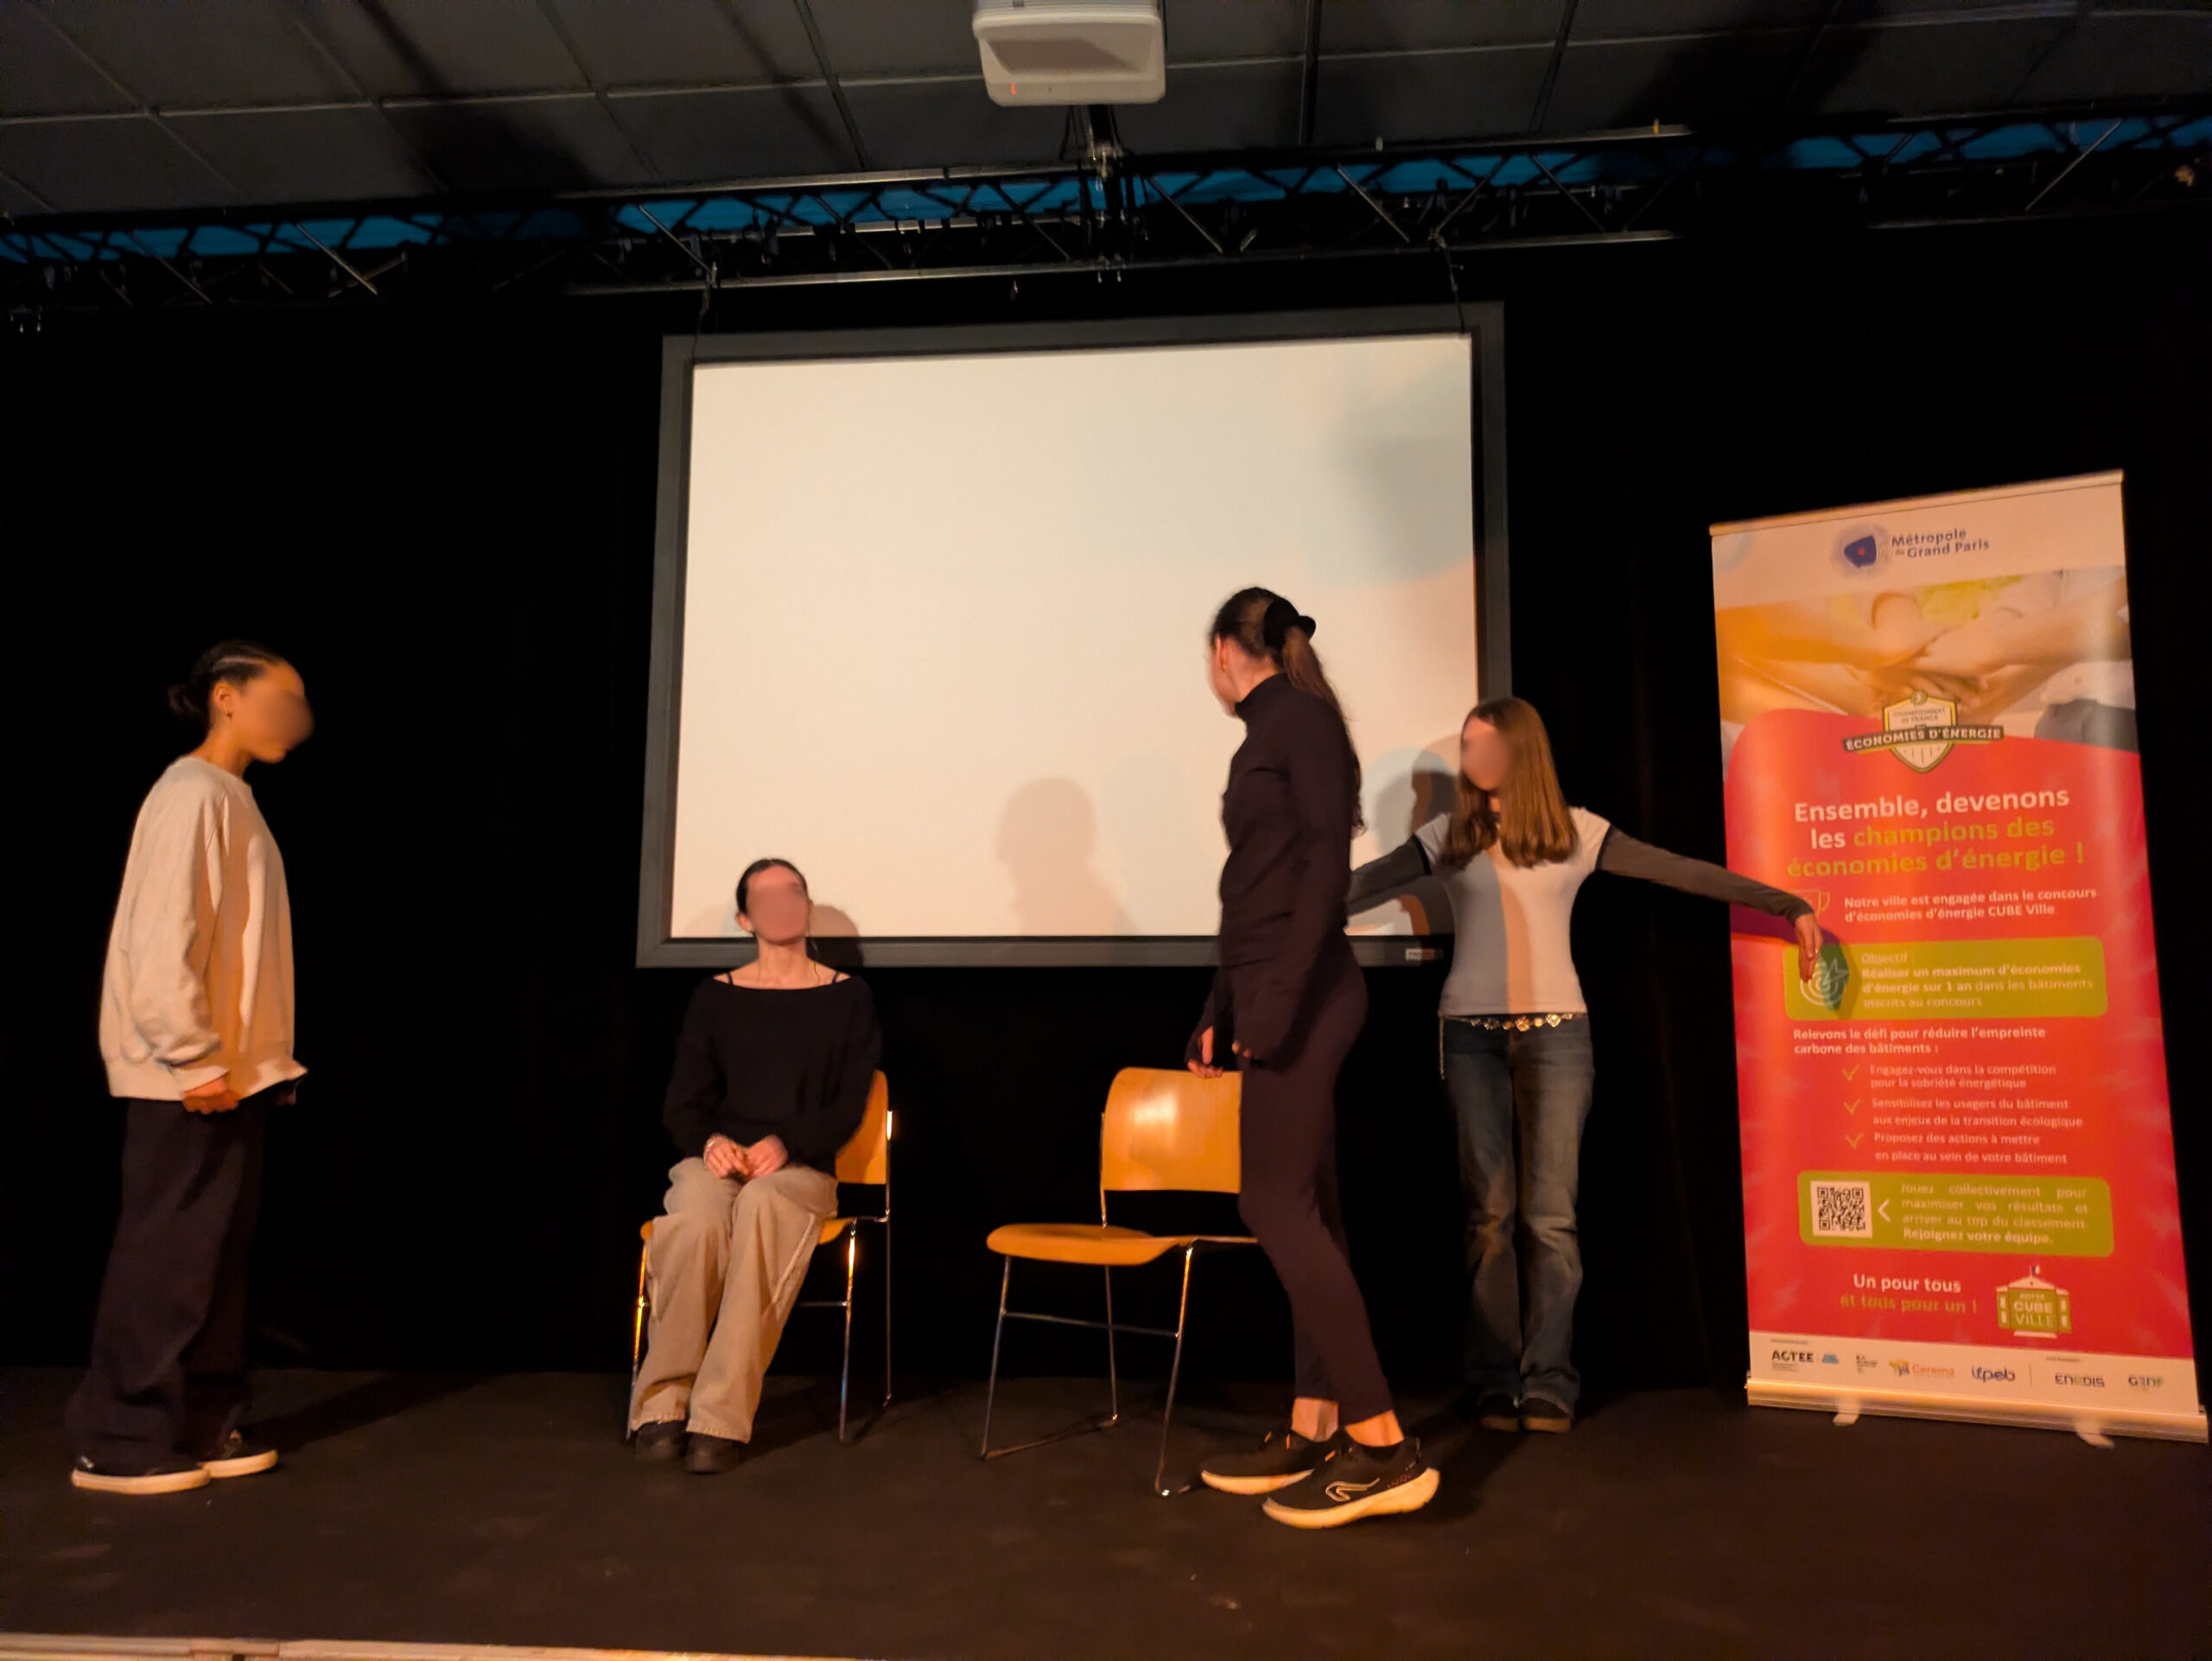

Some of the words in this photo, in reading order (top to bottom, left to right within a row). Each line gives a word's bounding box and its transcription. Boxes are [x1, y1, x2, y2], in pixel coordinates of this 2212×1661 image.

[1891, 528, 1967, 547] Métropole
[1907, 543, 1950, 557] Grand
[1955, 538, 1990, 552] Paris
[1846, 730, 1925, 750] ÉCONOMIES
[1929, 728, 2001, 740] D'ÉNERGIE
[1795, 795, 1928, 822] Ensemble,
[1936, 790, 2069, 813] devenons
[1811, 828, 1847, 850] les
[1853, 821, 1999, 847] champions
[2006, 818, 2054, 837] des
[1787, 854, 1928, 878] économies
[1936, 846, 2066, 871] d'énergie
[1845, 897, 1879, 907] Notre
[1882, 894, 1907, 906] ville
[1910, 895, 1929, 905] est
[1932, 892, 1986, 906] engagée
[1988, 891, 2019, 901] dans
[2022, 889, 2034, 901] le
[2037, 889, 2097, 900] concours
[1845, 909, 1923, 922] d'économies
[1926, 907, 1985, 920] d'énergie
[1988, 904, 2022, 917] CUBE
[2025, 904, 2055, 915] Ville
[1932, 965, 1995, 977] maximum
[1998, 963, 2081, 976] d'économies
[1863, 982, 1920, 996] d'énergie
[1923, 983, 1942, 992] sur
[1957, 983, 1972, 991] an
[1975, 980, 2005, 991] dans
[2008, 978, 2025, 990] les
[1793, 1028, 1847, 1040] Relevons
[1850, 1028, 1861, 1039] le
[1864, 1028, 1887, 1039] défi
[1891, 1029, 1919, 1041] pour
[1923, 1027, 1968, 1039] réduire
[1971, 1026, 2046, 1040] l'empreinte
[1794, 1044, 1842, 1054] carbone
[1845, 1043, 1866, 1053] des
[1869, 1042, 1932, 1053] bâtiments
[1946, 1065, 1972, 1074] dans
[1974, 1065, 1985, 1074] la
[1987, 1064, 2056, 1076] compétition
[1871, 1079, 1896, 1089] pour
[1899, 1078, 1908, 1087] la
[1936, 1098, 1951, 1109] les
[1954, 1100, 1996, 1111] usagers
[1999, 1098, 2014, 1109] du
[1894, 1115, 1931, 1128] enjeux
[1934, 1115, 1948, 1125] de
[1950, 1115, 1961, 1126] la
[1962, 1116, 2018, 1127] transition
[2019, 1115, 2083, 1129] écologique
[1926, 1132, 1946, 1143] des
[1948, 1133, 1988, 1144] actions
[1891, 1150, 1921, 1161] place
[1923, 1152, 1937, 1161] au
[1939, 1151, 1962, 1161] sein
[1964, 1151, 1979, 1161] de
[1981, 1153, 2012, 1163] votre
[1948, 1183, 2041, 1198] collectivement
[2056, 1188, 2087, 1200] pour
[1975, 1201, 1998, 1212] vos
[1947, 1216, 1962, 1225] au
[1967, 1216, 1989, 1228] top
[1992, 1216, 2009, 1226] du
[1903, 1227, 1964, 1243] Rejoignez
[1966, 1231, 2002, 1243] votre
[2004, 1231, 2054, 1245] équipe.
[1853, 1273, 1877, 1289] Un
[1881, 1277, 1920, 1292] pour
[1923, 1277, 1961, 1293] tous
[1860, 1295, 1896, 1310] tous
[1901, 1300, 1940, 1313] pour
[1944, 1301, 1967, 1313] un
[2014, 1301, 2053, 1314] CUBE
[1771, 1351, 1815, 1362] ACTEE
